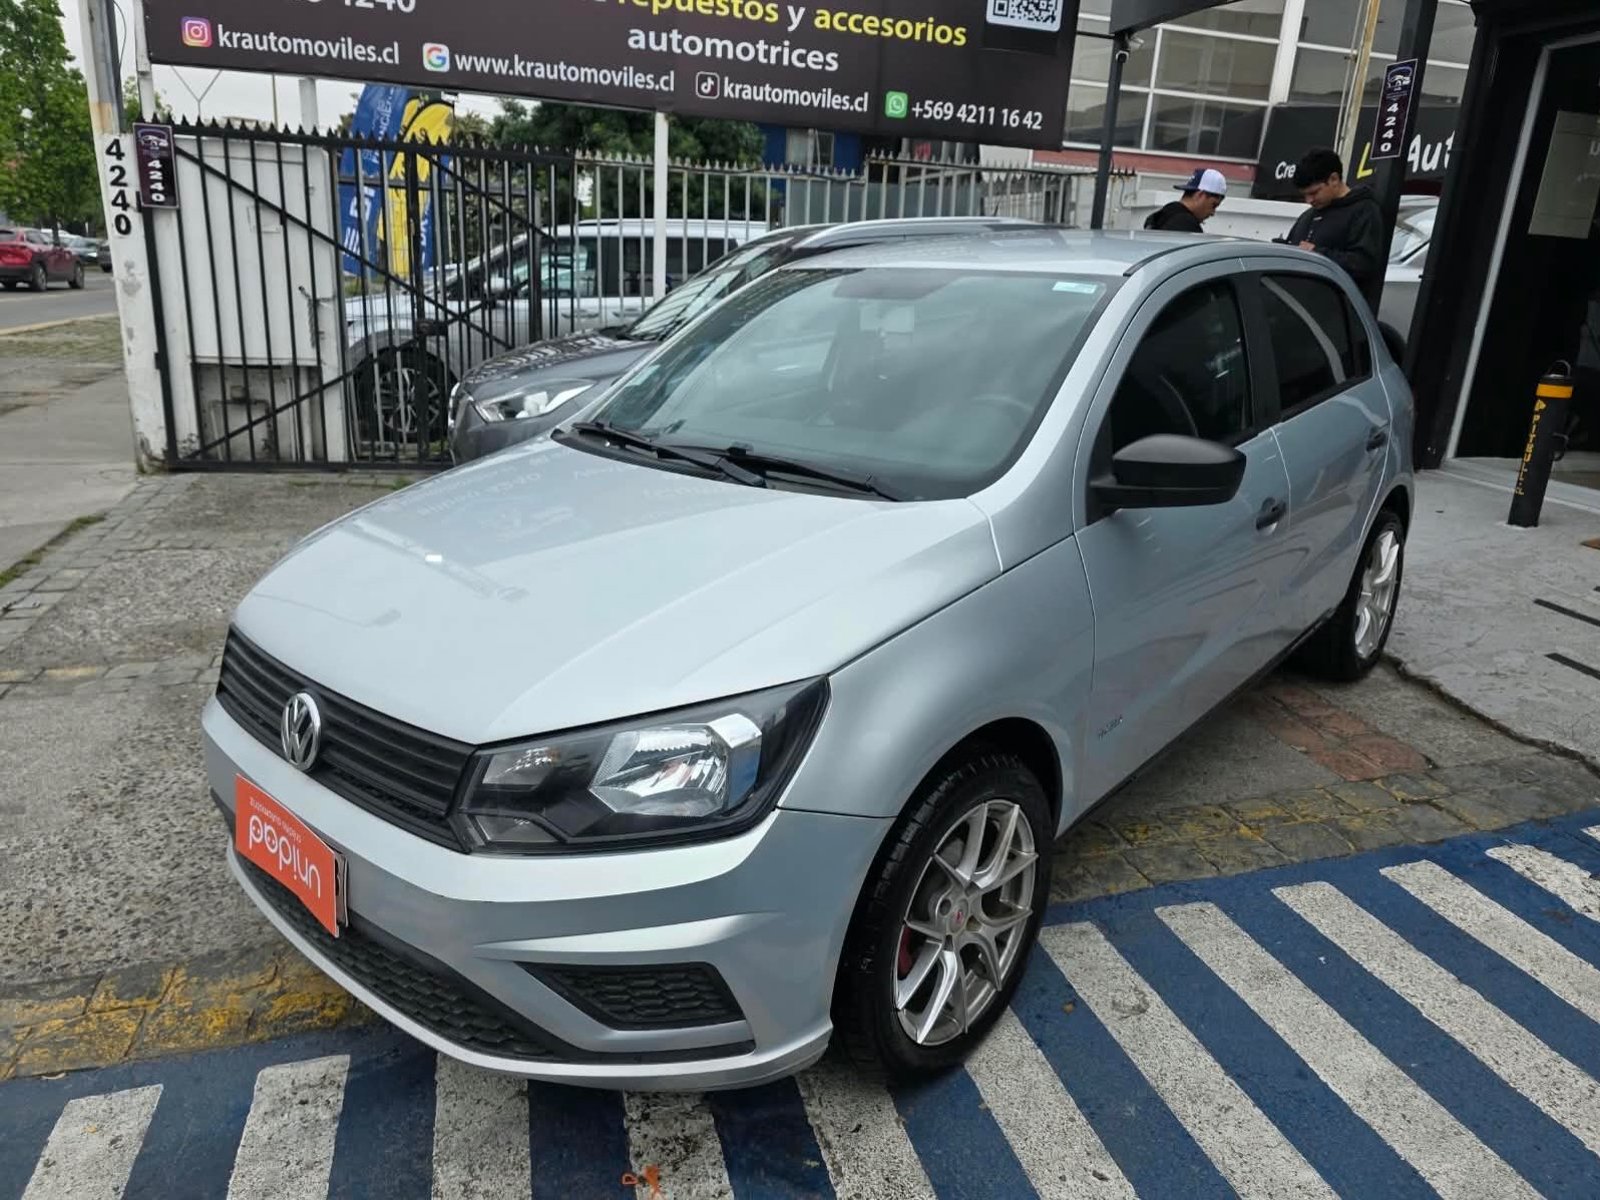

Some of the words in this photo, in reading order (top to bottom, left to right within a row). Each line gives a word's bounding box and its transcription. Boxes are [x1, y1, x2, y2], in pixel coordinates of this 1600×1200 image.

[217, 24, 400, 65] krautomoviles.cl
[618, 0, 778, 23] puestos
[787, 4, 806, 32] y
[813, 8, 968, 47] accesorios
[627, 28, 839, 72] automotrices
[454, 54, 676, 92] www.krautomoviles.cl
[723, 76, 869, 112] krautomoviles.cl
[912, 99, 954, 121] +569
[956, 103, 996, 126] 4211
[1001, 108, 1020, 127] 16
[1022, 110, 1043, 130] 42
[1380, 102, 1399, 152] 4240
[104, 138, 132, 235] 4240
[147, 159, 165, 202] 4240
[250, 814, 321, 899] unidad
